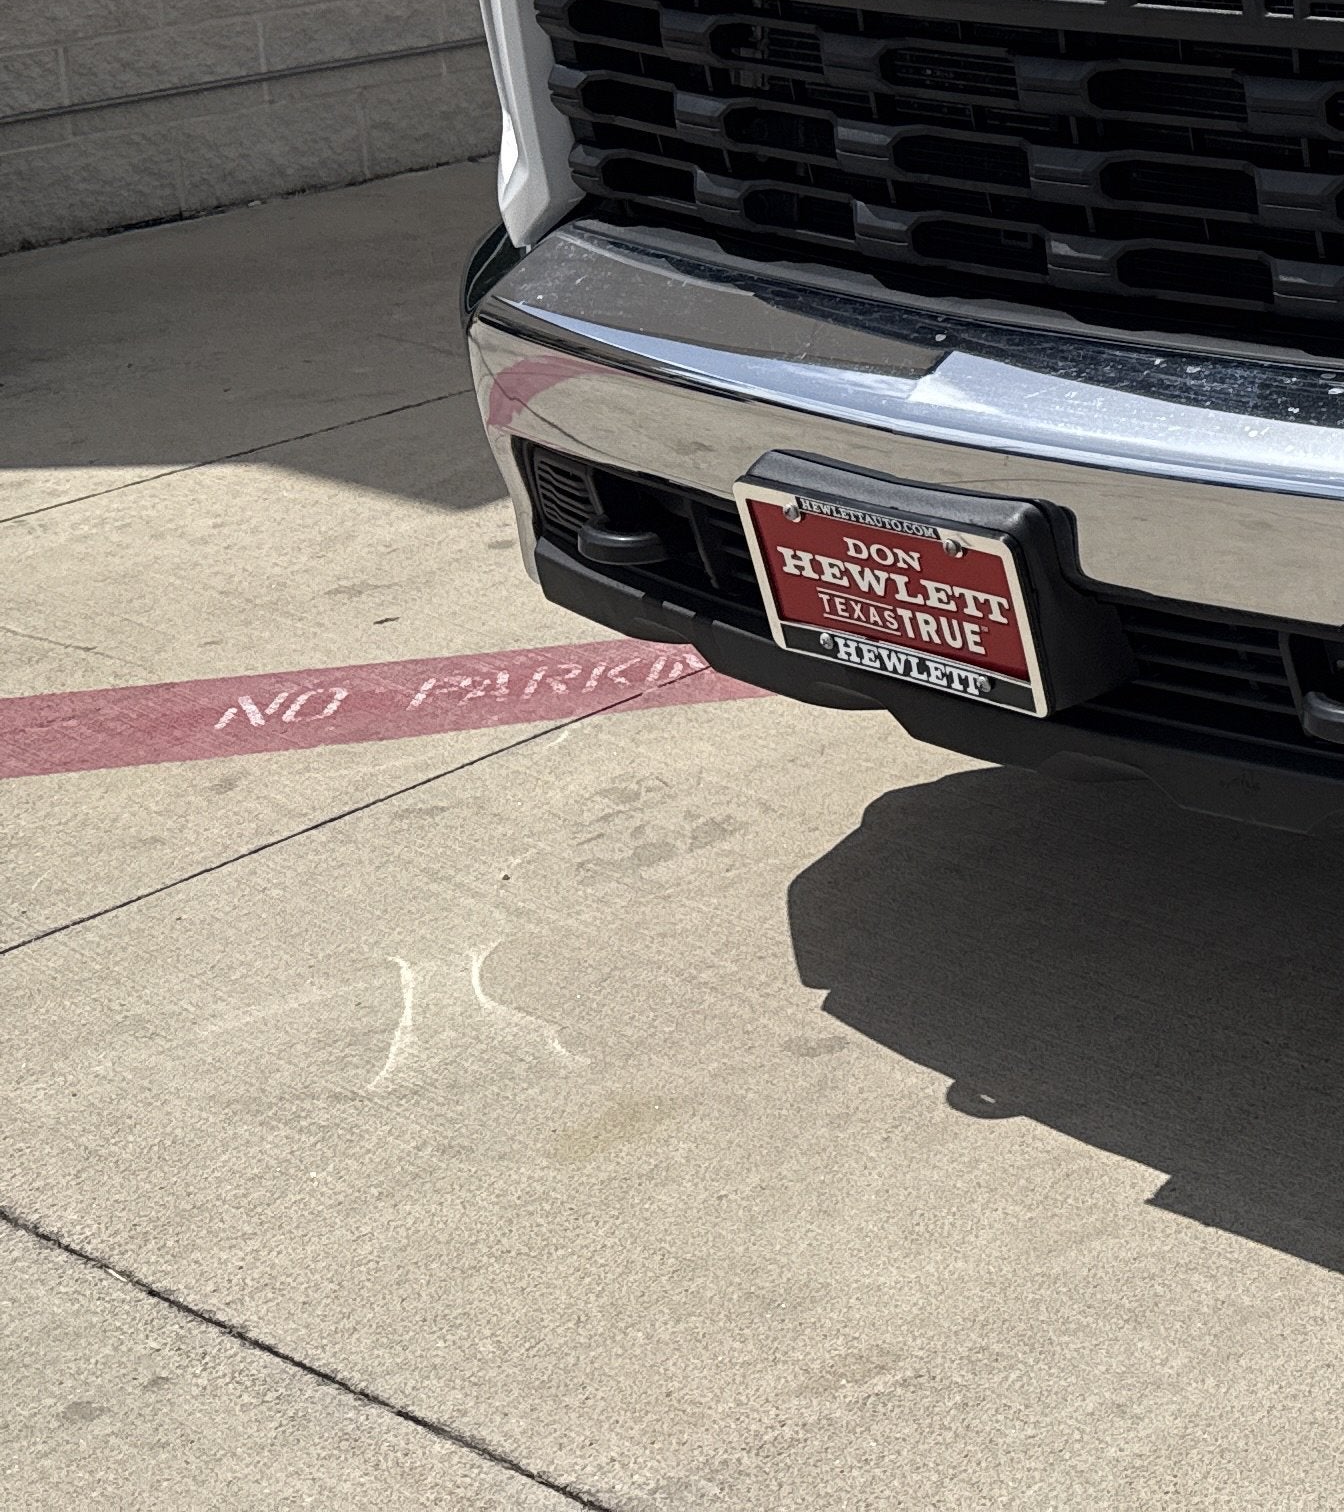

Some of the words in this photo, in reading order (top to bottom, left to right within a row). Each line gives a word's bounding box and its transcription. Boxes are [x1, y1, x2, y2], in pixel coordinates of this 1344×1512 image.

[801, 497, 938, 539] HEWLETTAUTO.COM
[843, 536, 922, 572] DON
[776, 545, 1010, 625] HEWLETT
[213, 686, 349, 730] NO
[406, 651, 706, 713] PARKIN
[835, 637, 984, 696] HEWLETT
